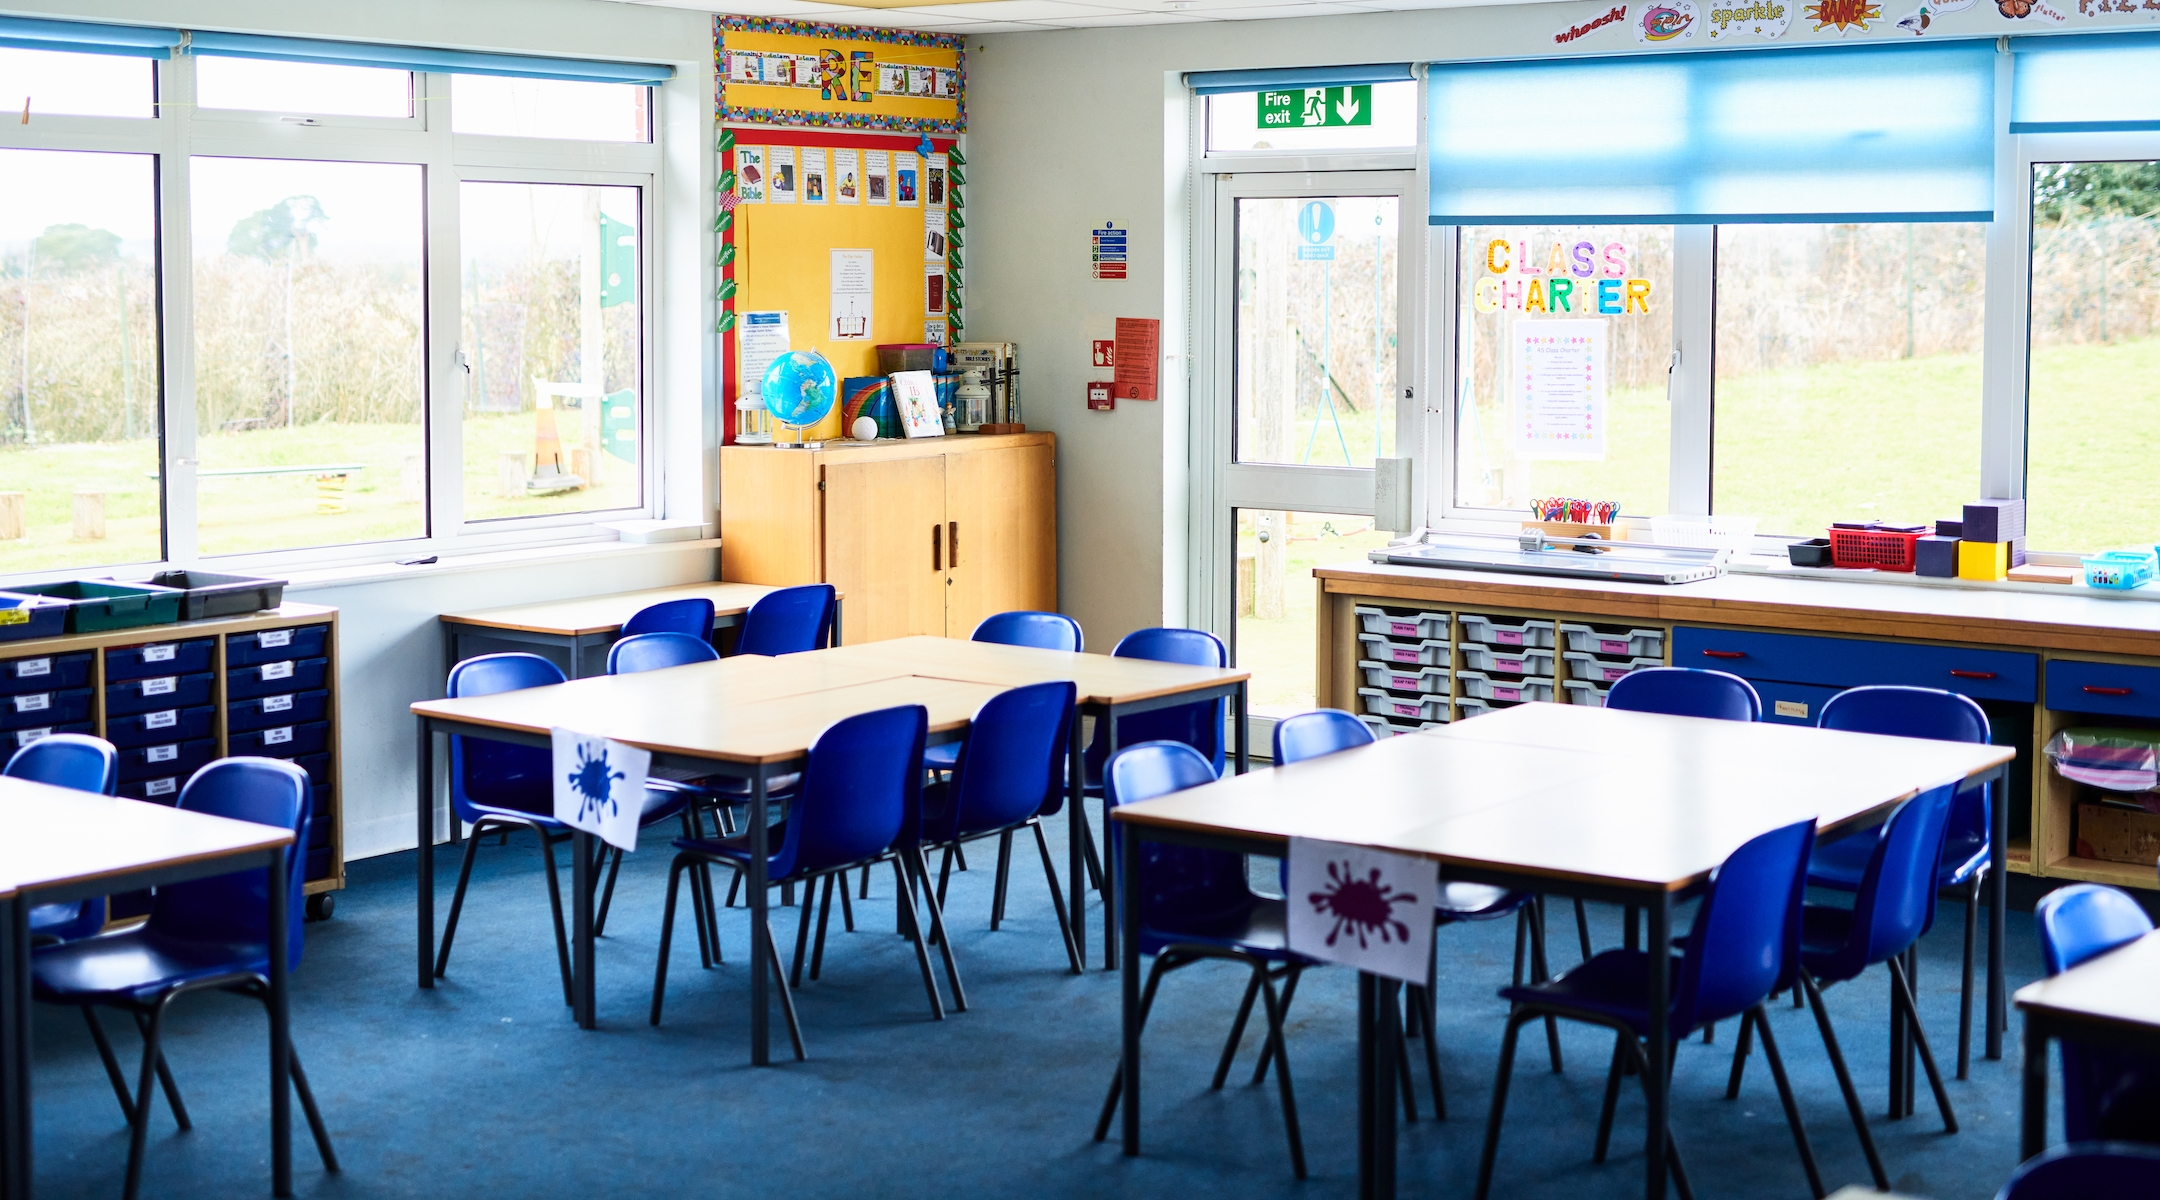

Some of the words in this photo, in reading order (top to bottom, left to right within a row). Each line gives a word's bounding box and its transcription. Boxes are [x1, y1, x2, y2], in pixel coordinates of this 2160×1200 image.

[1711, 1, 1785, 29] sparkle
[1819, 0, 1865, 22] BANG!
[2034, 4, 2066, 22] flutter
[1556, 6, 1626, 44] whoosh!
[820, 49, 874, 102] RE
[1265, 92, 1291, 106] Fire
[1265, 110, 1290, 124] exit
[740, 151, 760, 164] The
[718, 175, 732, 190] service
[741, 186, 762, 200] Bible
[951, 214, 960, 224] trust
[717, 248, 732, 266] sacrifice
[1487, 239, 1627, 278] CLASS
[949, 272, 962, 288] courage
[1474, 276, 1652, 315] CHARTER
[718, 314, 733, 332] justice
[949, 312, 962, 326] peace
